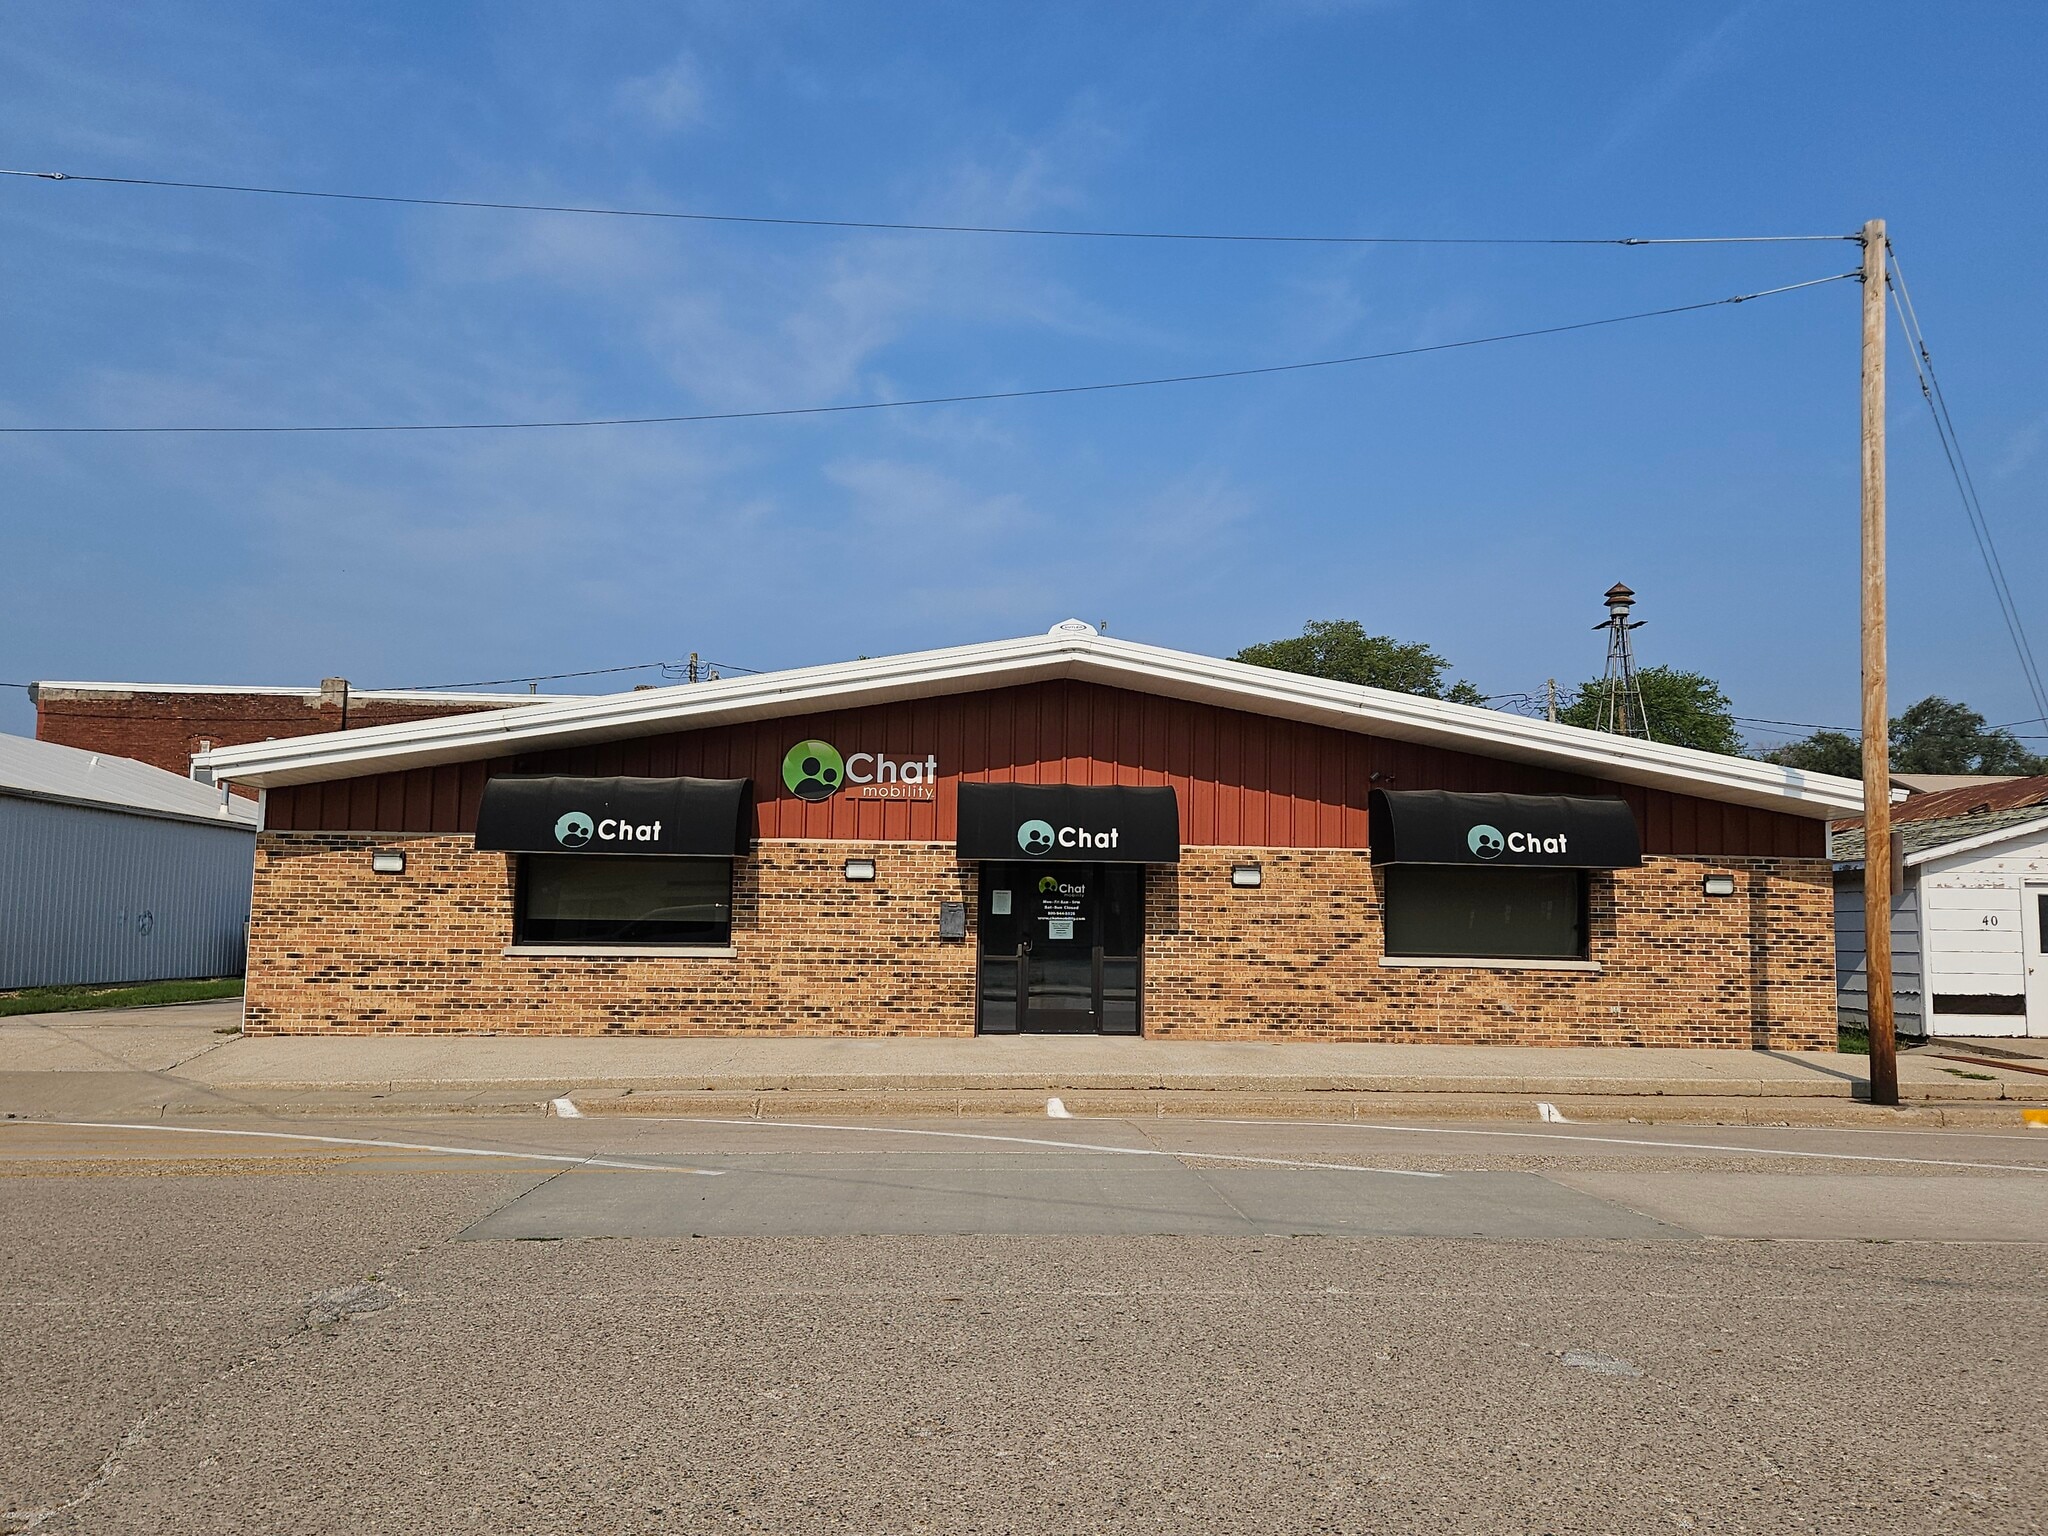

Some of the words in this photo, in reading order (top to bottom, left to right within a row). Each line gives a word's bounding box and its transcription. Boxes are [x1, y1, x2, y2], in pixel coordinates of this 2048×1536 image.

[846, 753, 937, 784] Chat
[863, 785, 934, 800] mobility
[598, 819, 661, 841] Chat
[1058, 826, 1119, 848] Chat
[1507, 832, 1567, 853] Chat
[1059, 884, 1085, 893] Chat
[1982, 915, 1998, 926] 40
